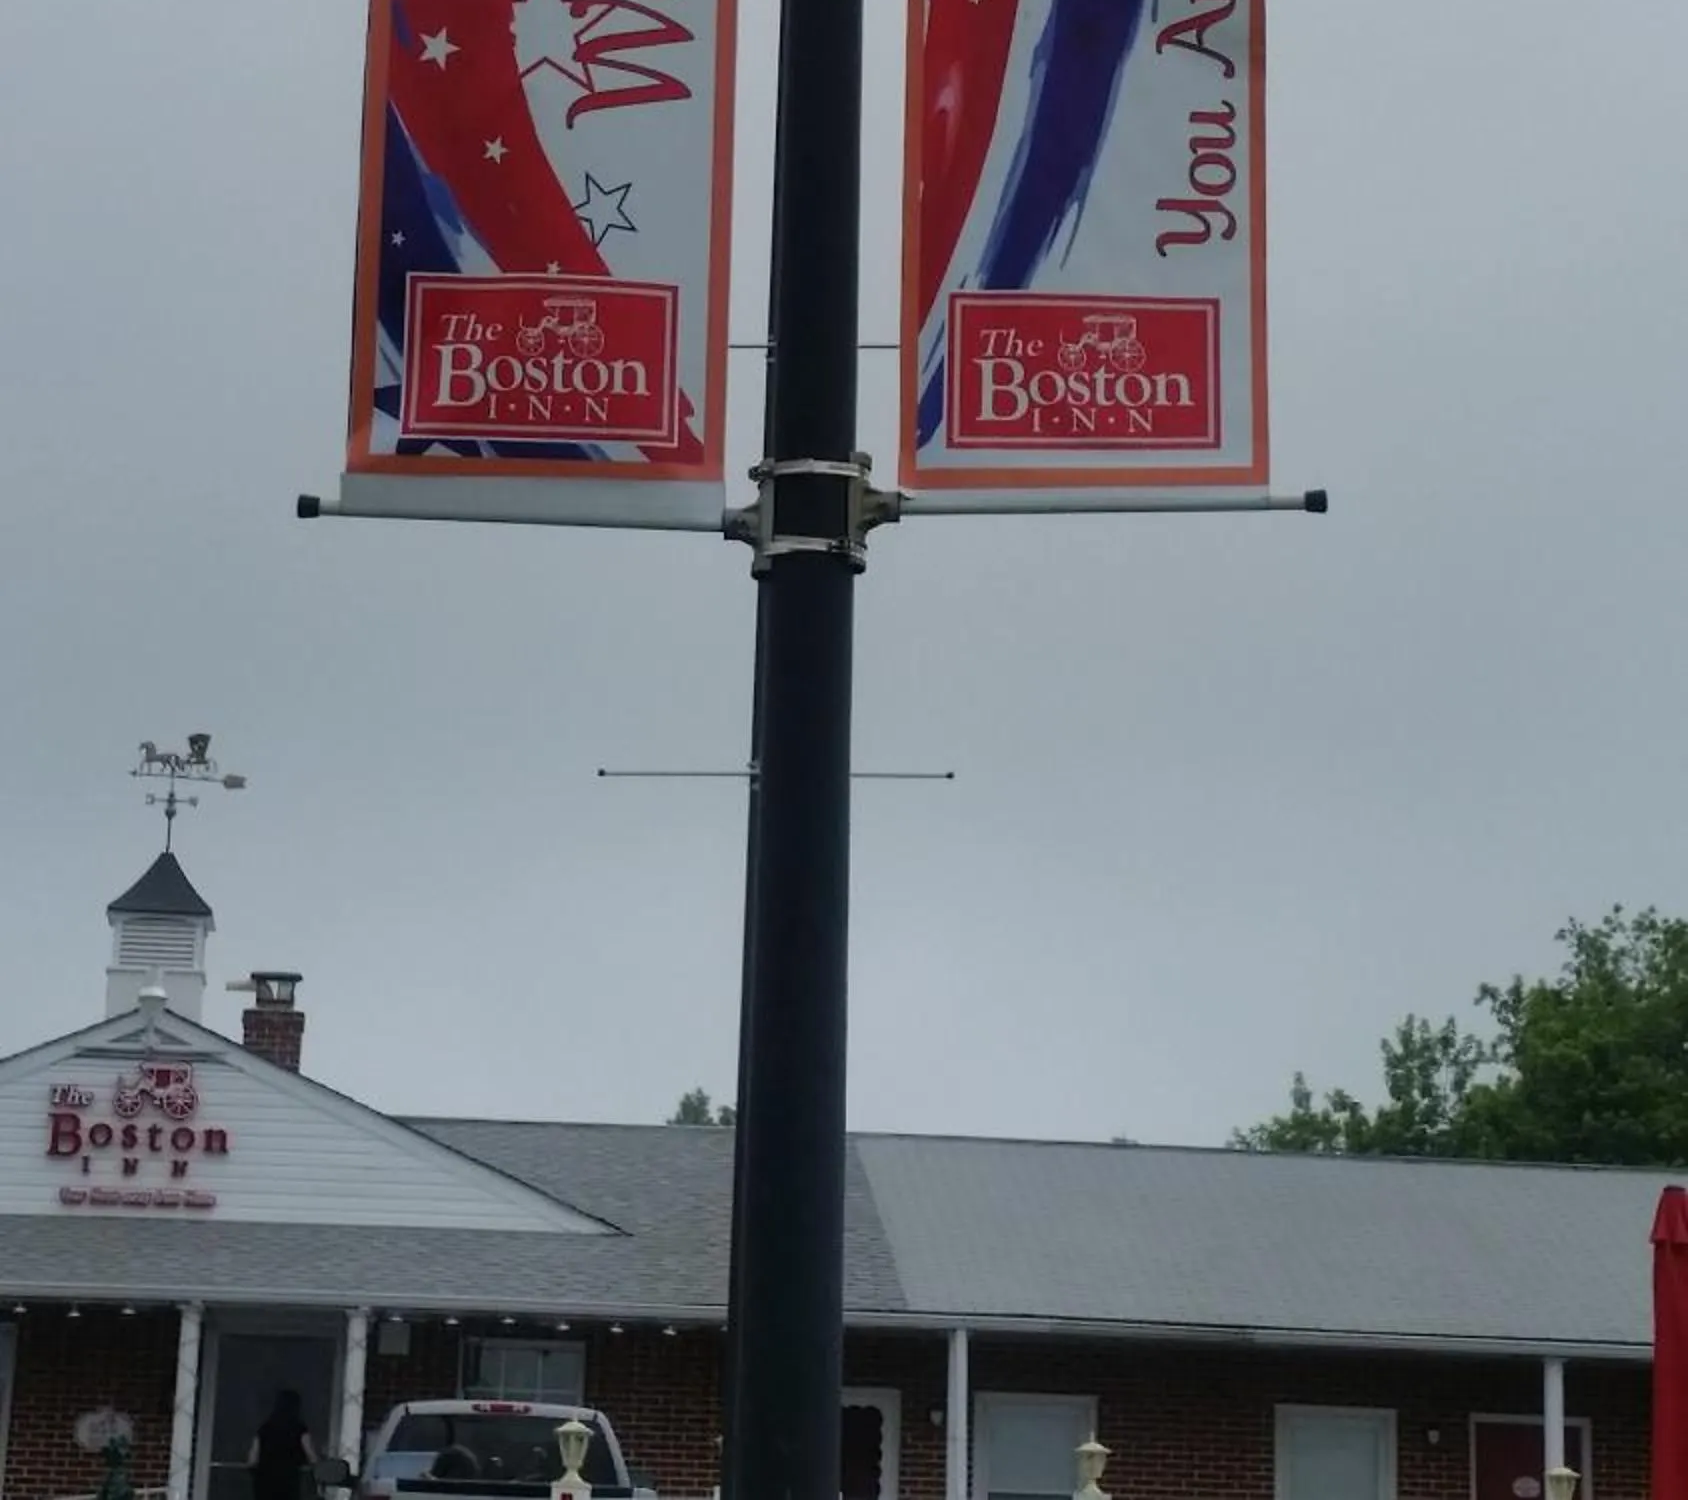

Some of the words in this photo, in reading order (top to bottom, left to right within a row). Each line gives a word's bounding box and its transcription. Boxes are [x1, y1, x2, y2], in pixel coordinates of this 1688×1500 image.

[1156, 101, 1237, 257] You
[440, 313, 503, 342] The
[979, 328, 1045, 357] The
[432, 343, 651, 407] Boston
[973, 357, 1195, 421] Boston
[51, 1083, 94, 1107] The
[47, 1112, 229, 1156] Boston
